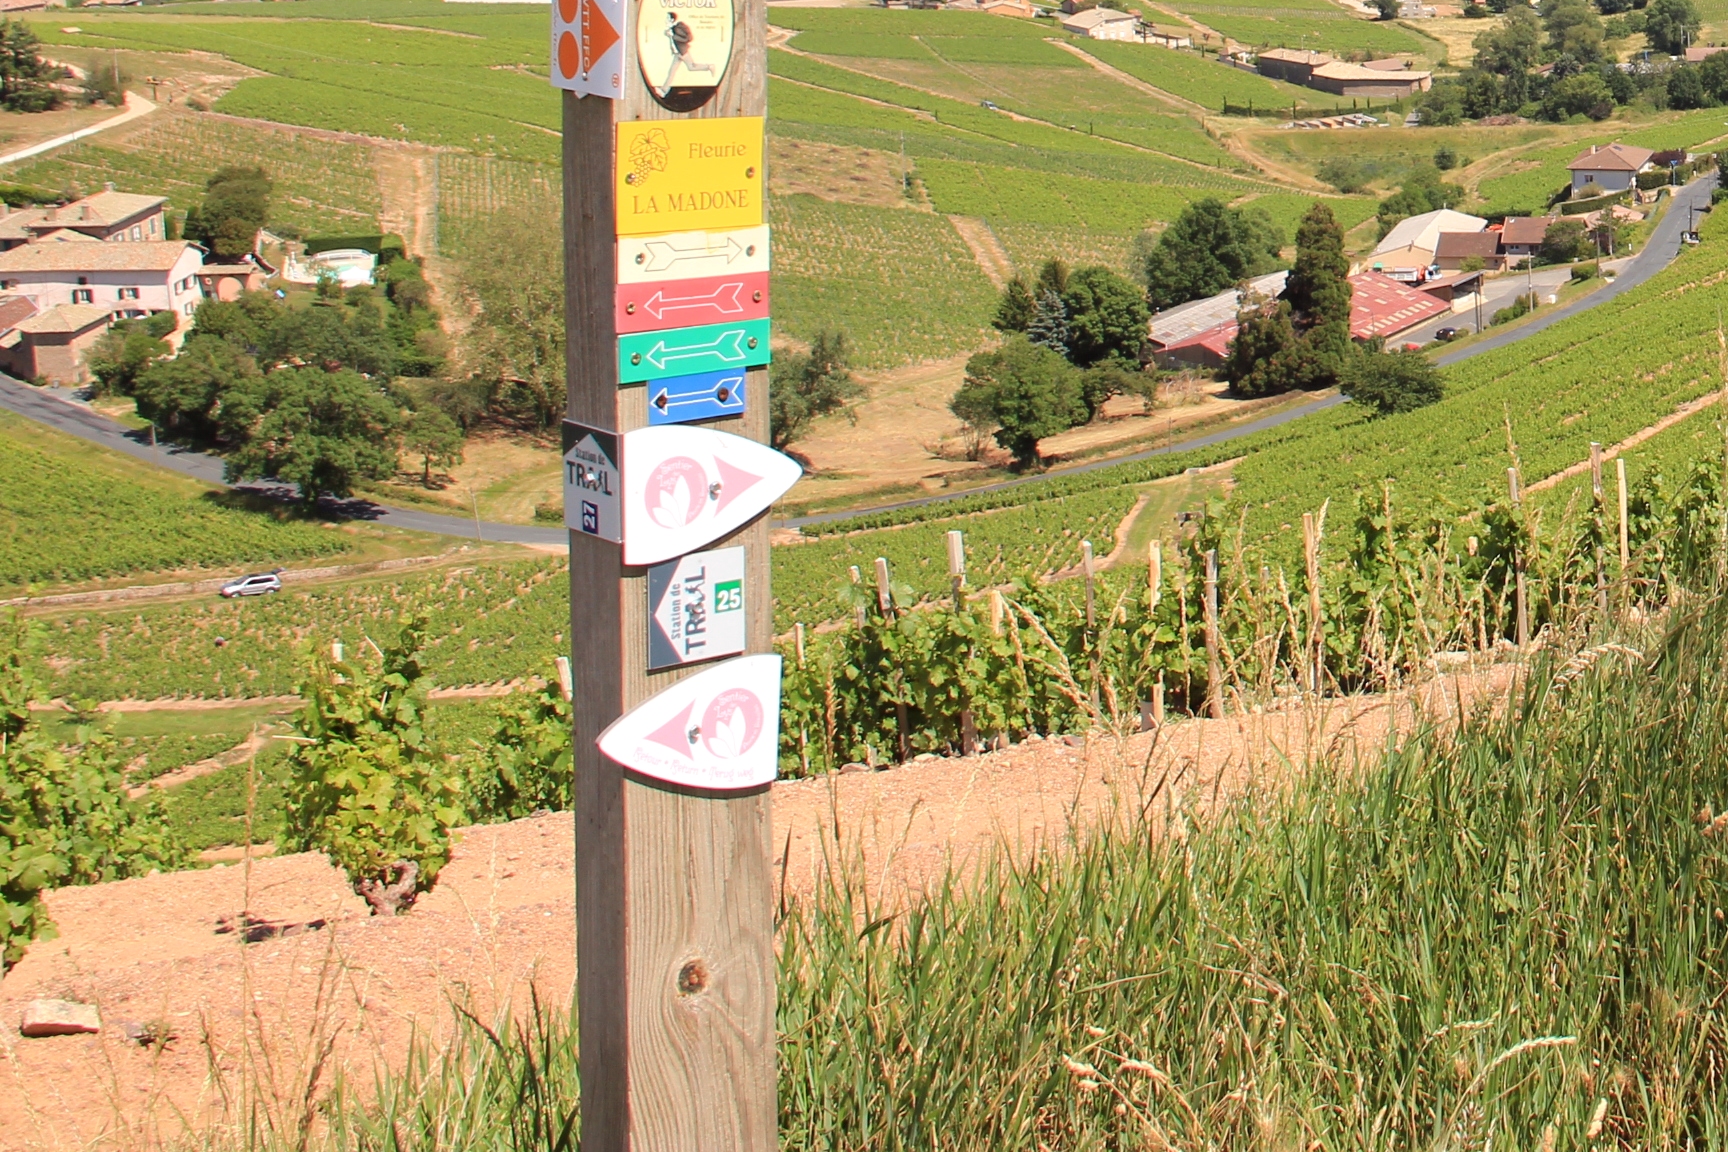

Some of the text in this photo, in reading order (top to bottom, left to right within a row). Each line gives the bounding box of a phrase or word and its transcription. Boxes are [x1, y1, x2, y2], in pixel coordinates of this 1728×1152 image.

[582, 34, 591, 69] FFC
[689, 141, 747, 159] Fleurie
[632, 189, 750, 215] LA MADONE
[575, 447, 605, 465] Station de
[583, 503, 596, 529] 27
[670, 582, 681, 640] Station de
[716, 586, 741, 611] 25
[669, 758, 700, 776] Return
